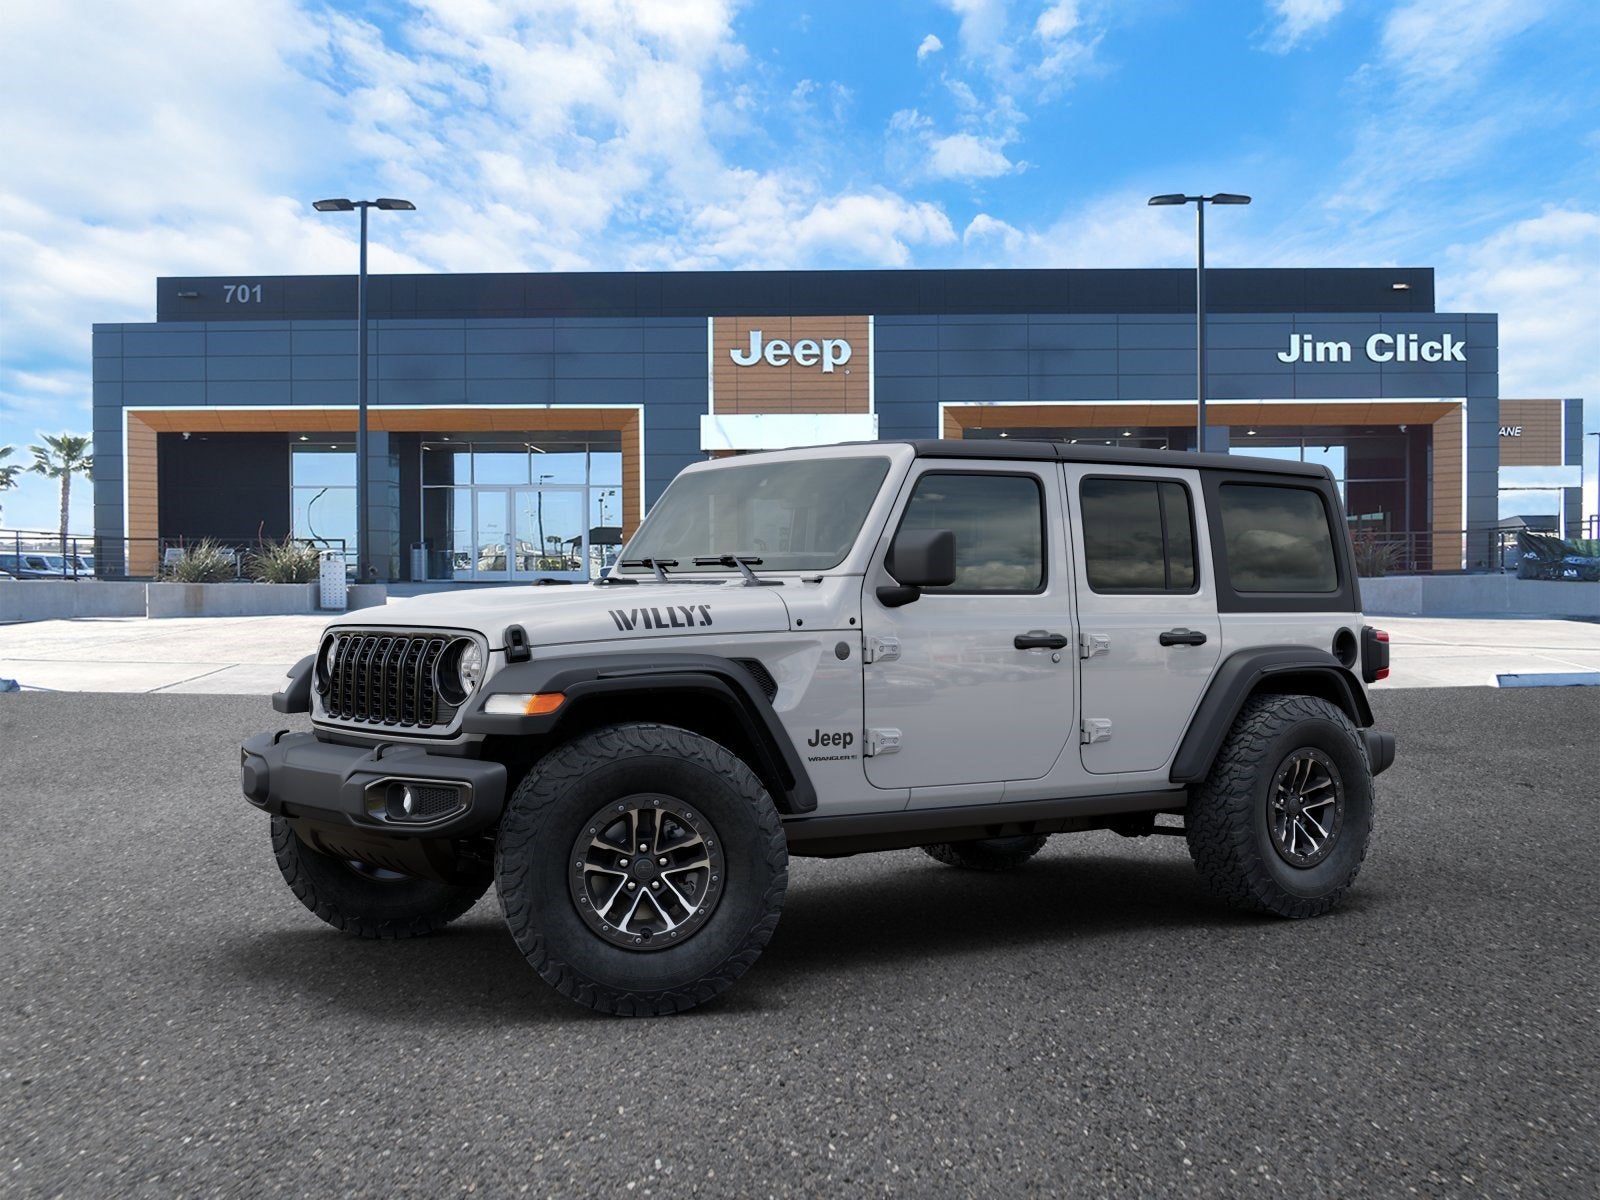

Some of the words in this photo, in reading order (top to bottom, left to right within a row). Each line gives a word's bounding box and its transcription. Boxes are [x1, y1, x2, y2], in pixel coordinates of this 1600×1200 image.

[223, 284, 262, 304] 701
[729, 330, 852, 374] Jeep
[1277, 333, 1352, 363] Jim
[1365, 333, 1467, 363] Click
[608, 604, 713, 632] WILLYS
[807, 729, 854, 750] Jeep
